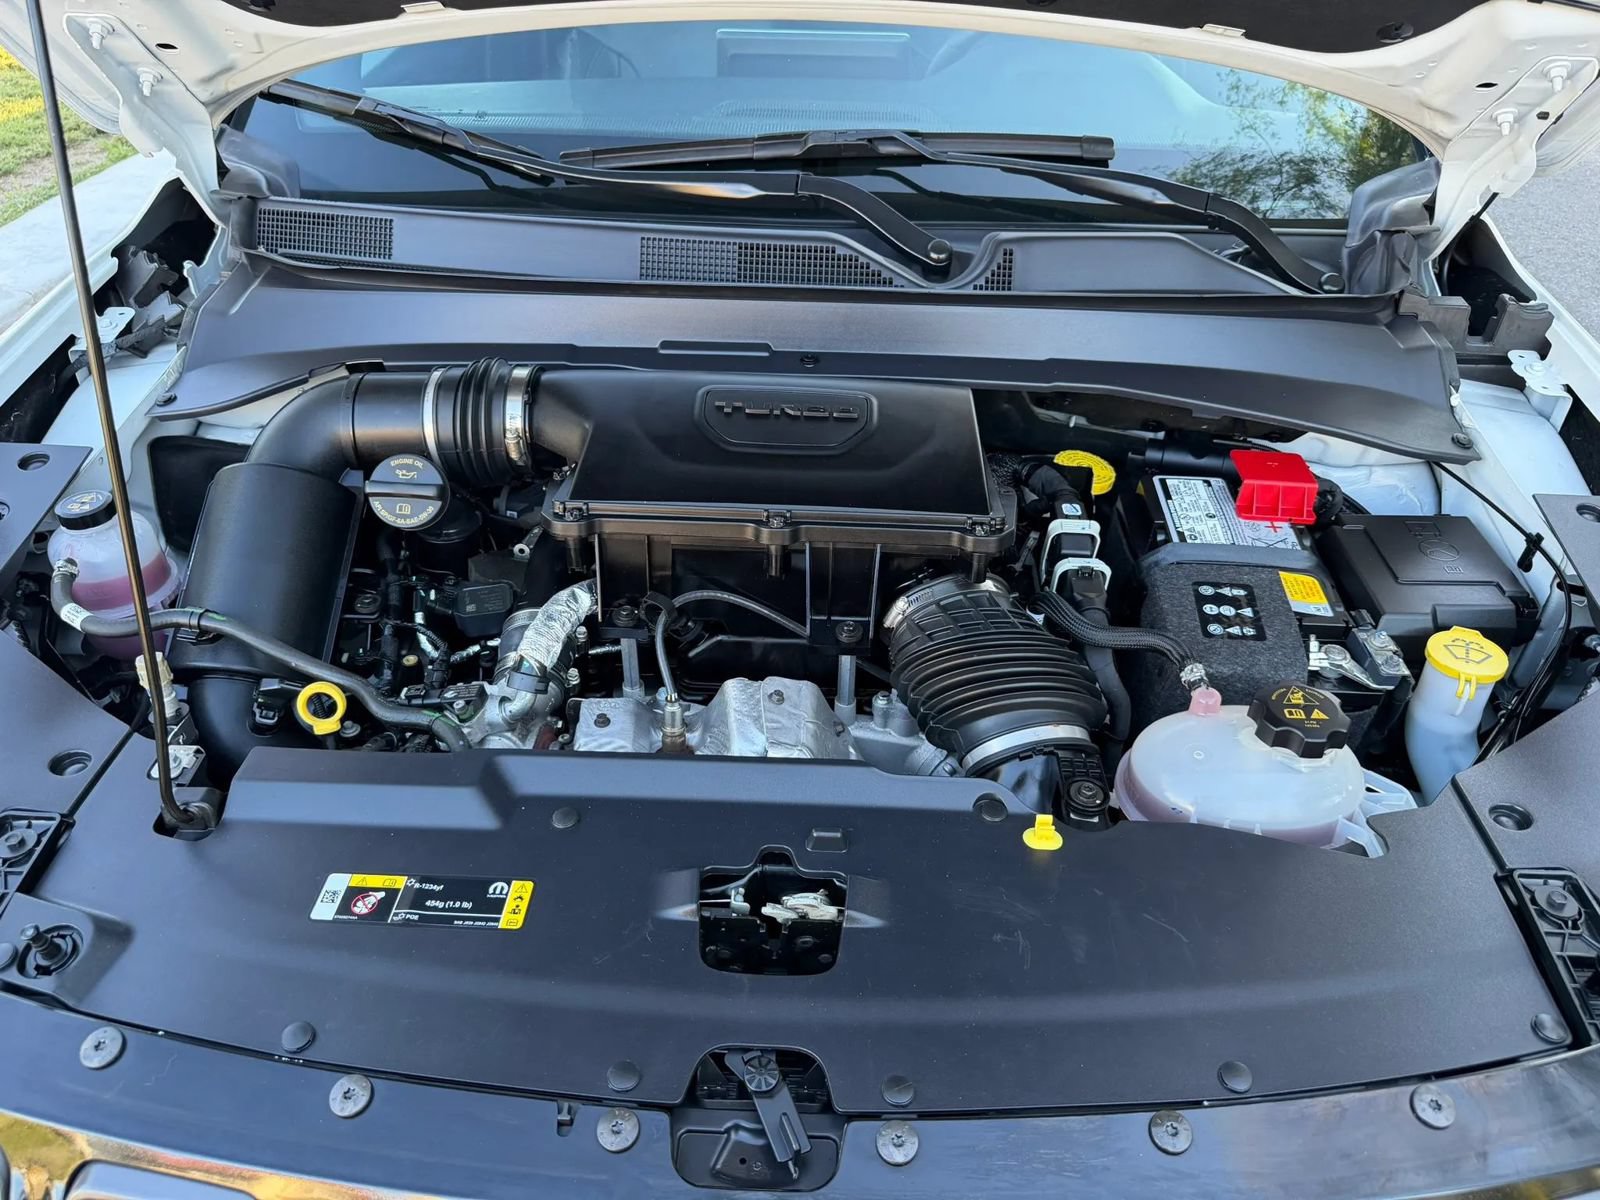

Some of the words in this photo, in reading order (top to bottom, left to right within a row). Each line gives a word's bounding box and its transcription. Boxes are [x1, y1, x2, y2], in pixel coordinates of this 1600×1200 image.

[714, 401, 859, 419] TURBO
[390, 457, 414, 467] ENGINE
[414, 459, 424, 470] OIL
[373, 501, 382, 511] API
[414, 882, 444, 892] R-1234yf
[425, 899, 445, 909] 454g
[445, 900, 461, 909] (1.0
[461, 901, 473, 910] lb)
